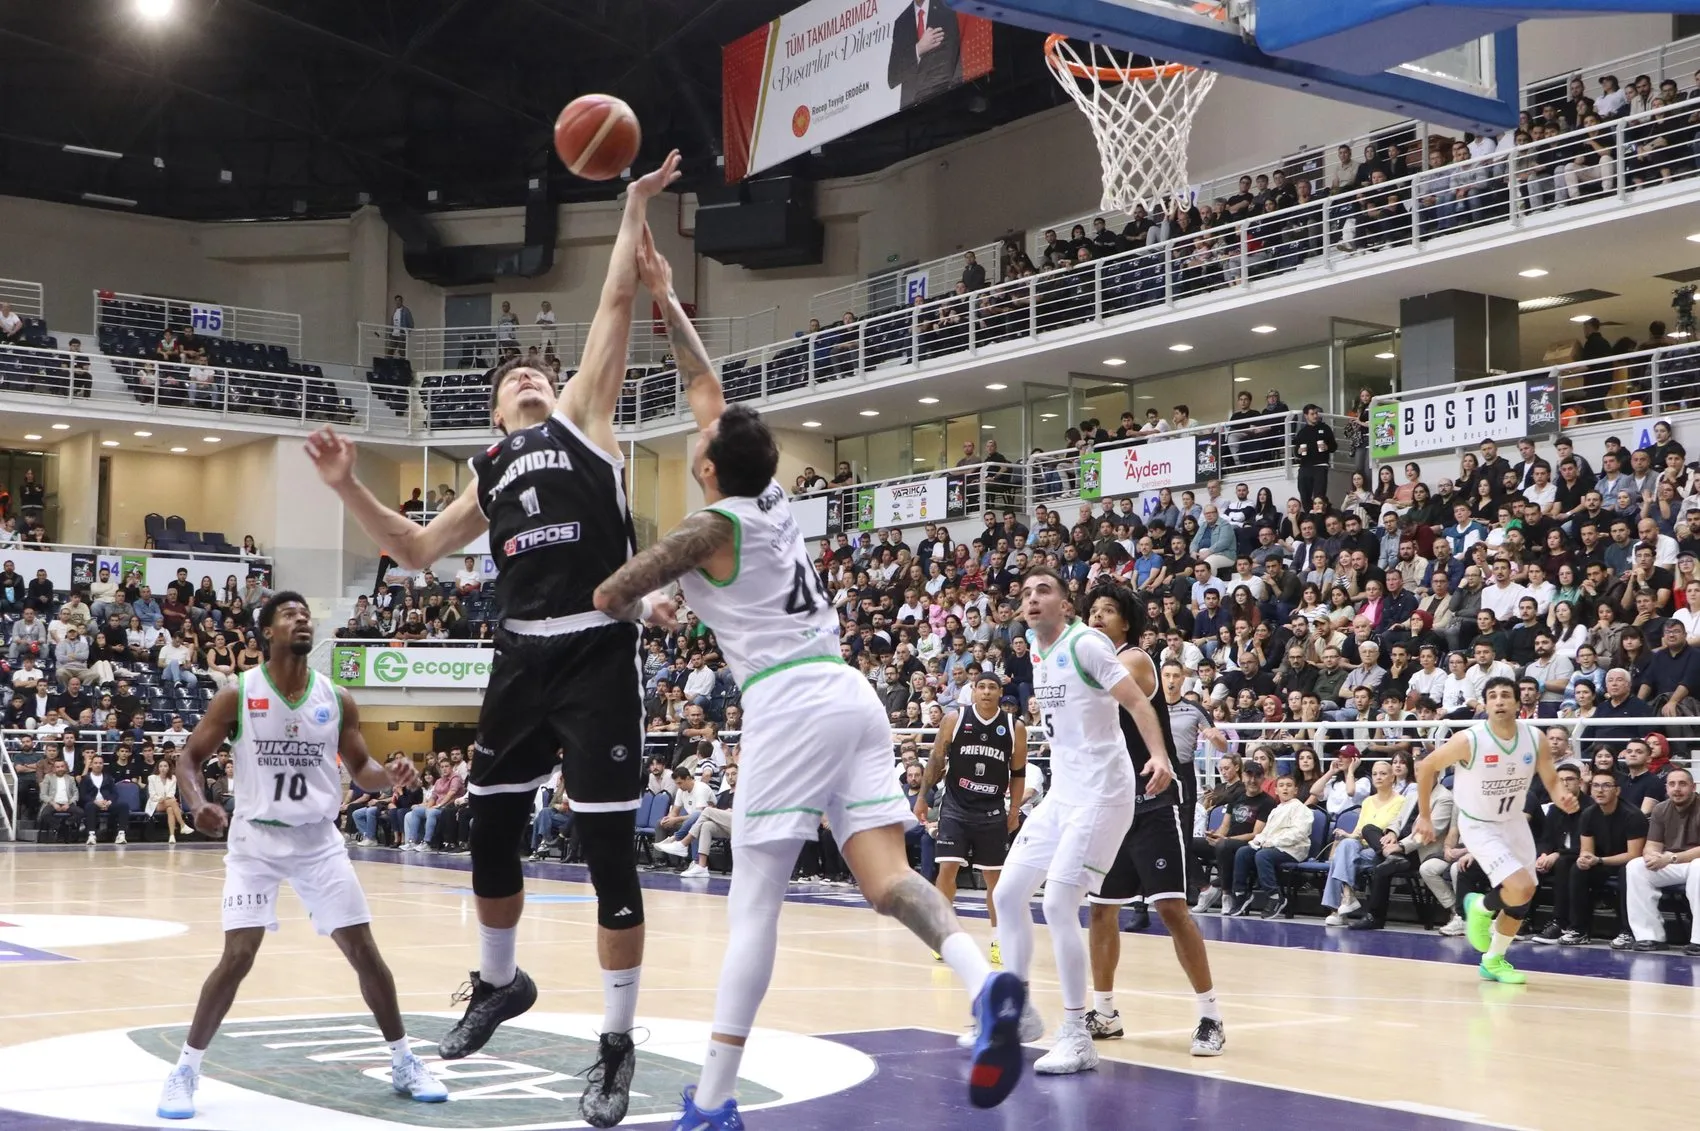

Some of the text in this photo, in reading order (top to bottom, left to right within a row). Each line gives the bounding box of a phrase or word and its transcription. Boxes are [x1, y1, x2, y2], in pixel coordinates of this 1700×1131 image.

[785, 0, 878, 59] TÜM TAKIMLARIMIZA
[772, 21, 892, 92] Başarılar Dilerim
[192, 308, 221, 331] H5
[1404, 389, 1519, 436] BOSTON
[1125, 460, 1171, 482] Aydem
[517, 526, 574, 549] TIPOS
[484, 559, 495, 573] D
[1045, 714, 1054, 738] 5
[960, 745, 1005, 762] PRIEVIDZA
[273, 772, 308, 802] 10
[969, 781, 996, 793] TIPOS
[1498, 796, 1516, 815] 11
